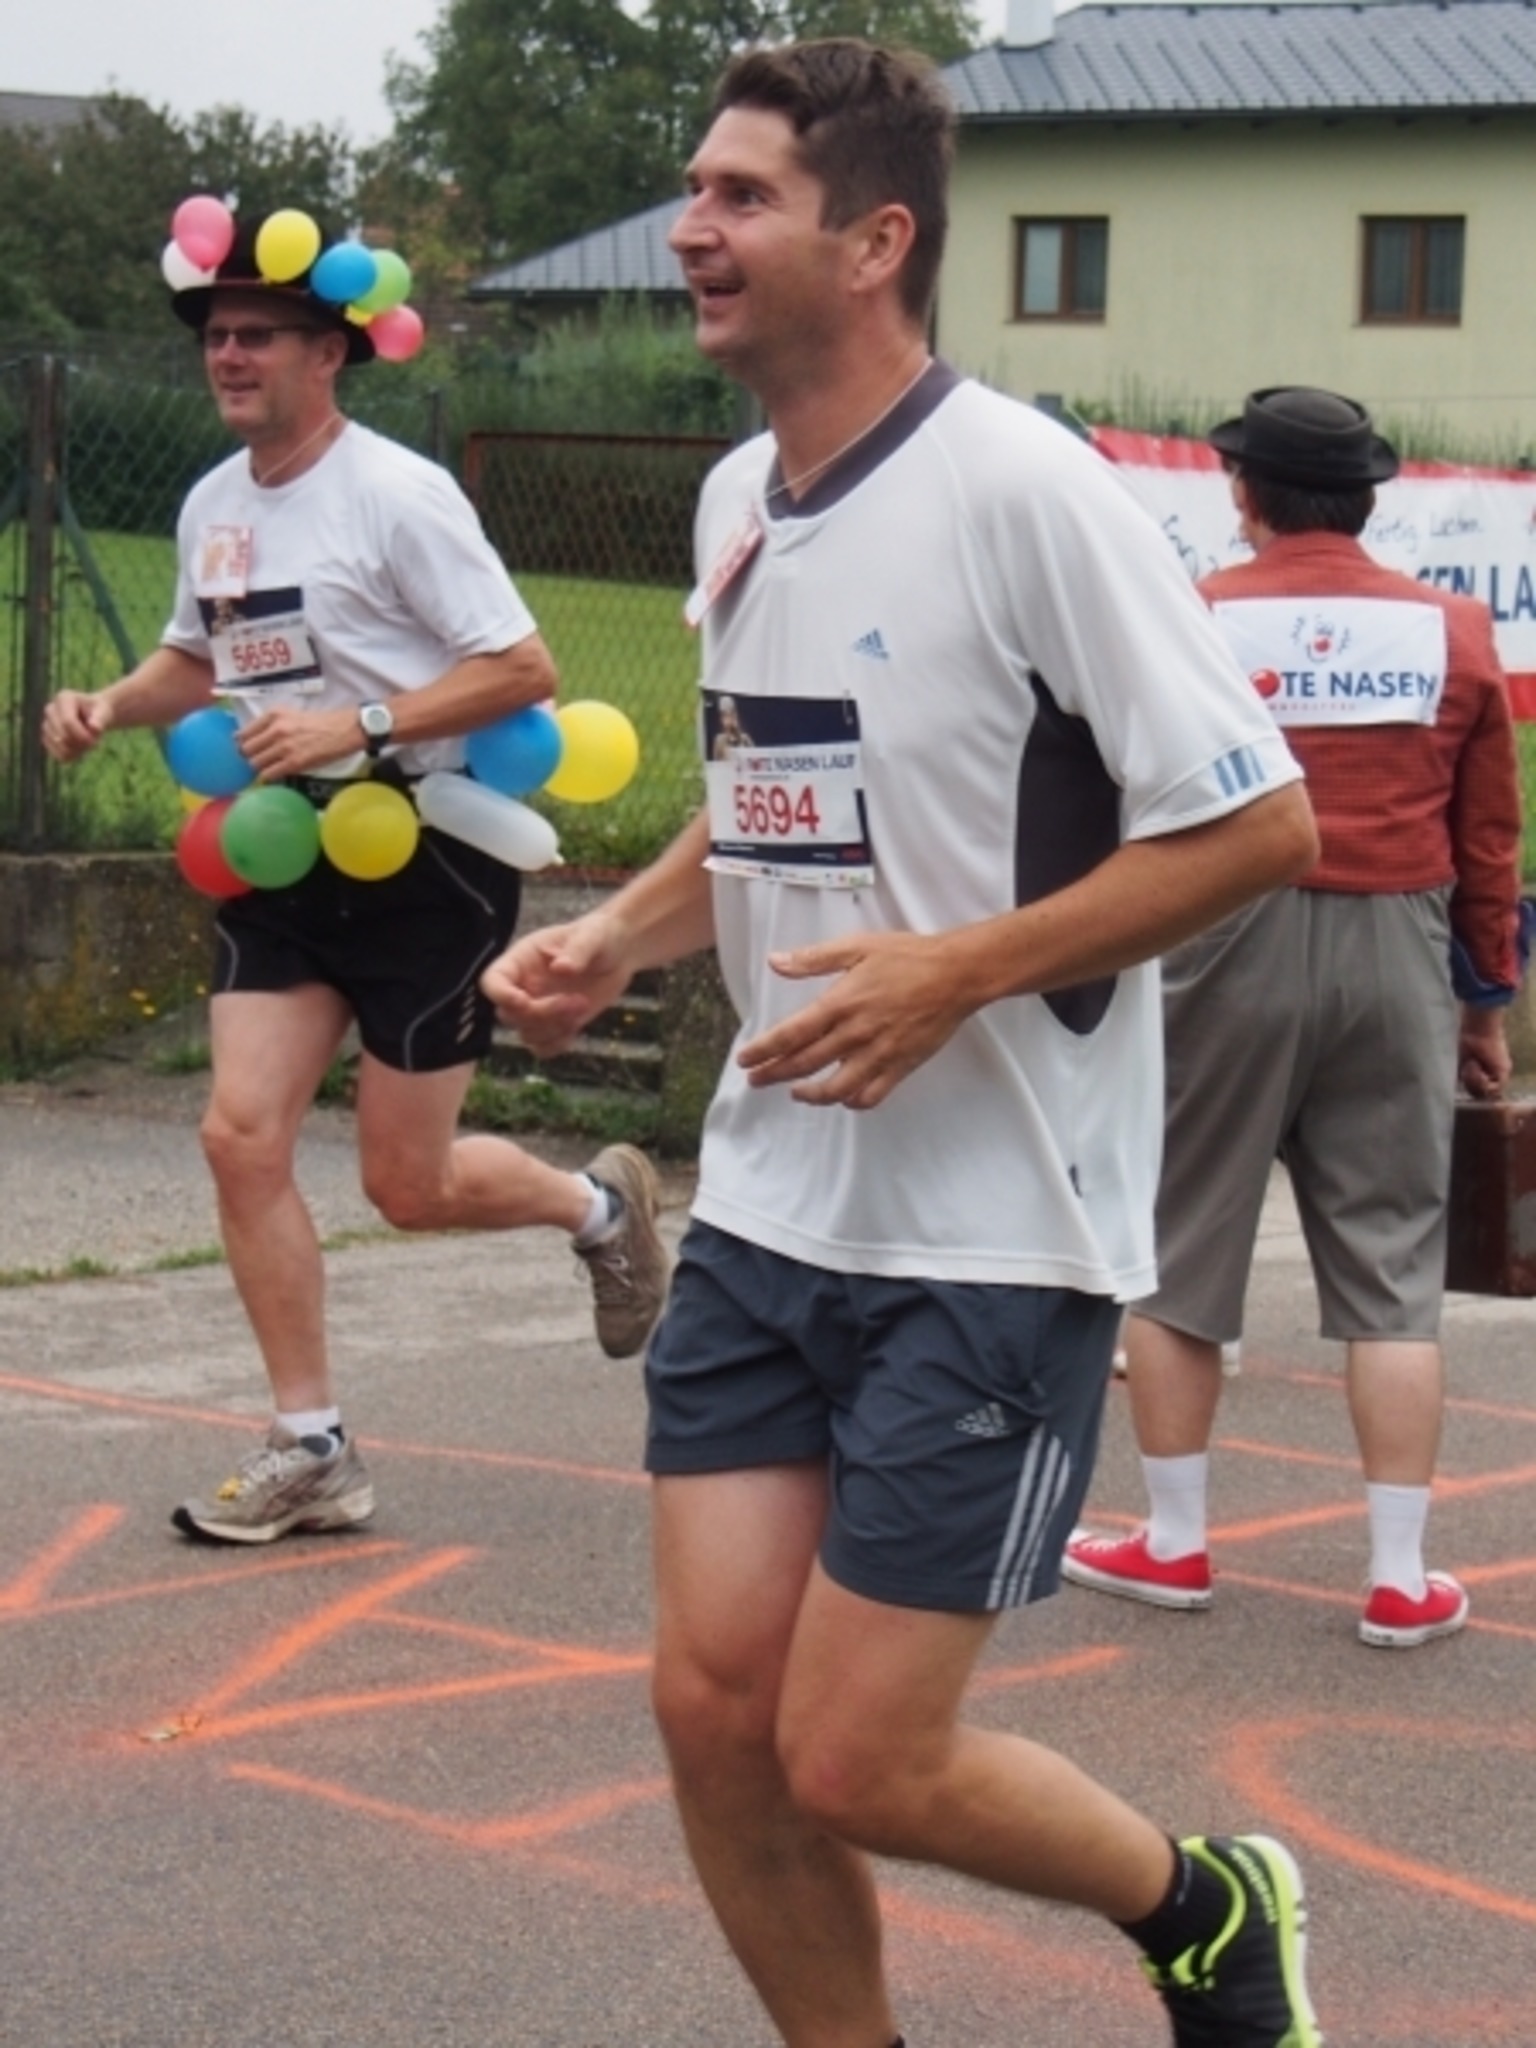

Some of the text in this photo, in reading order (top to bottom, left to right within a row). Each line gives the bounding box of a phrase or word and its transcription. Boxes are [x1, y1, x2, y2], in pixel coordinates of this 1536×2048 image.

[232, 638, 292, 673] 5659
[1330, 671, 1437, 698] NASEN
[734, 784, 820, 836] 5694
